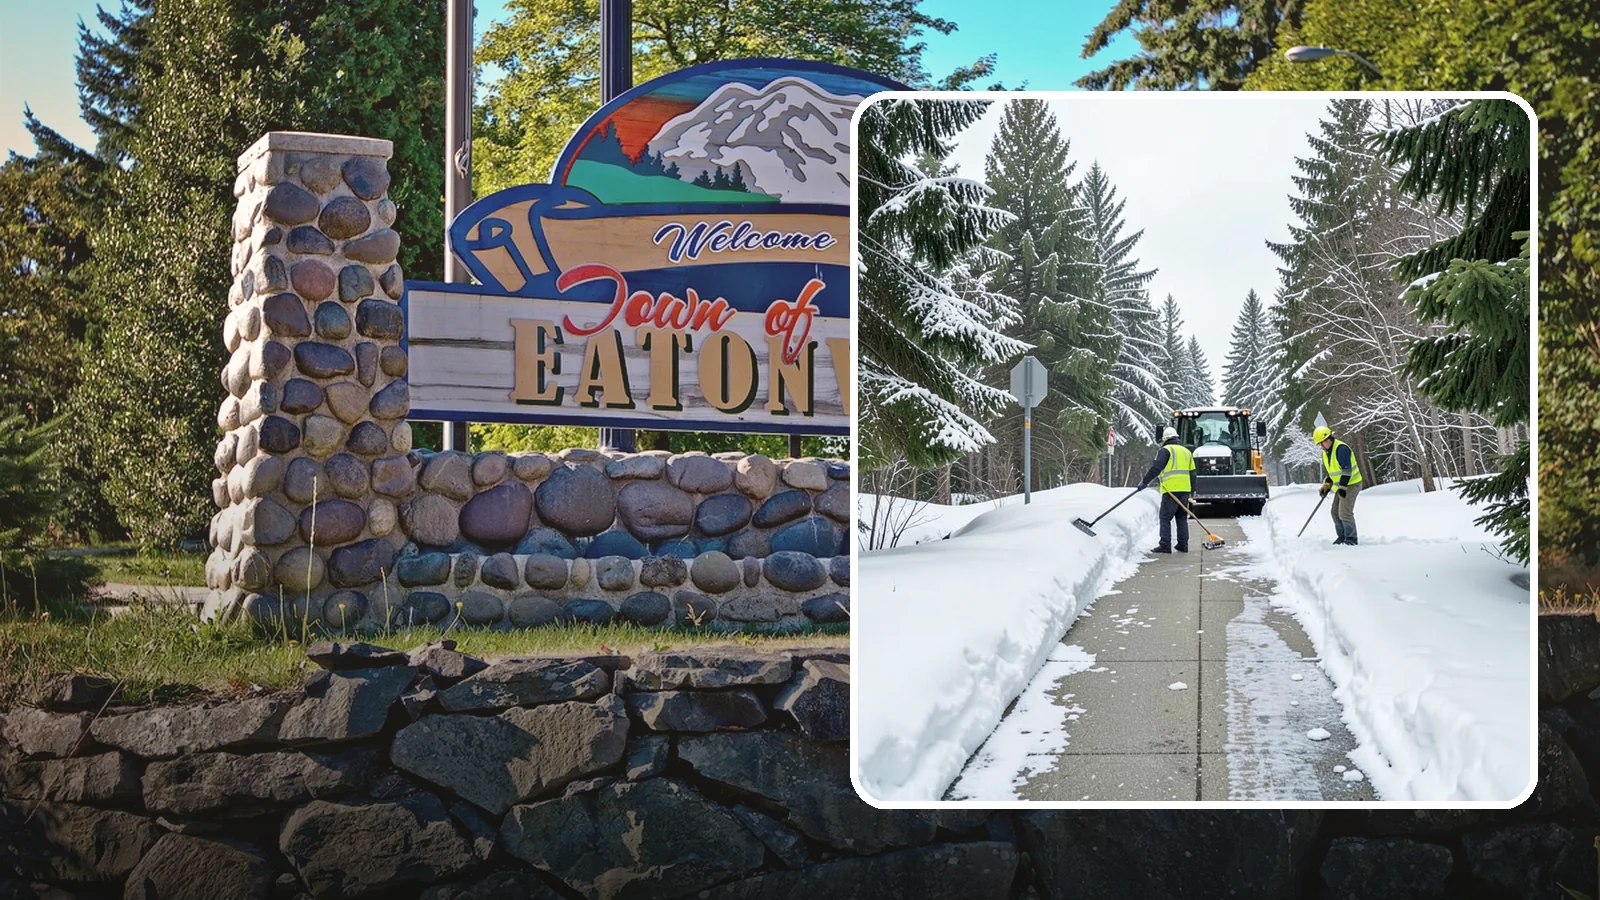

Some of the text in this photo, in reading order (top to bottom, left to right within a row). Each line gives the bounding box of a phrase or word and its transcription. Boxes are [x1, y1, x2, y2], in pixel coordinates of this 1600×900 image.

[652, 220, 837, 263] Welcome
[556, 263, 826, 366] Town of
